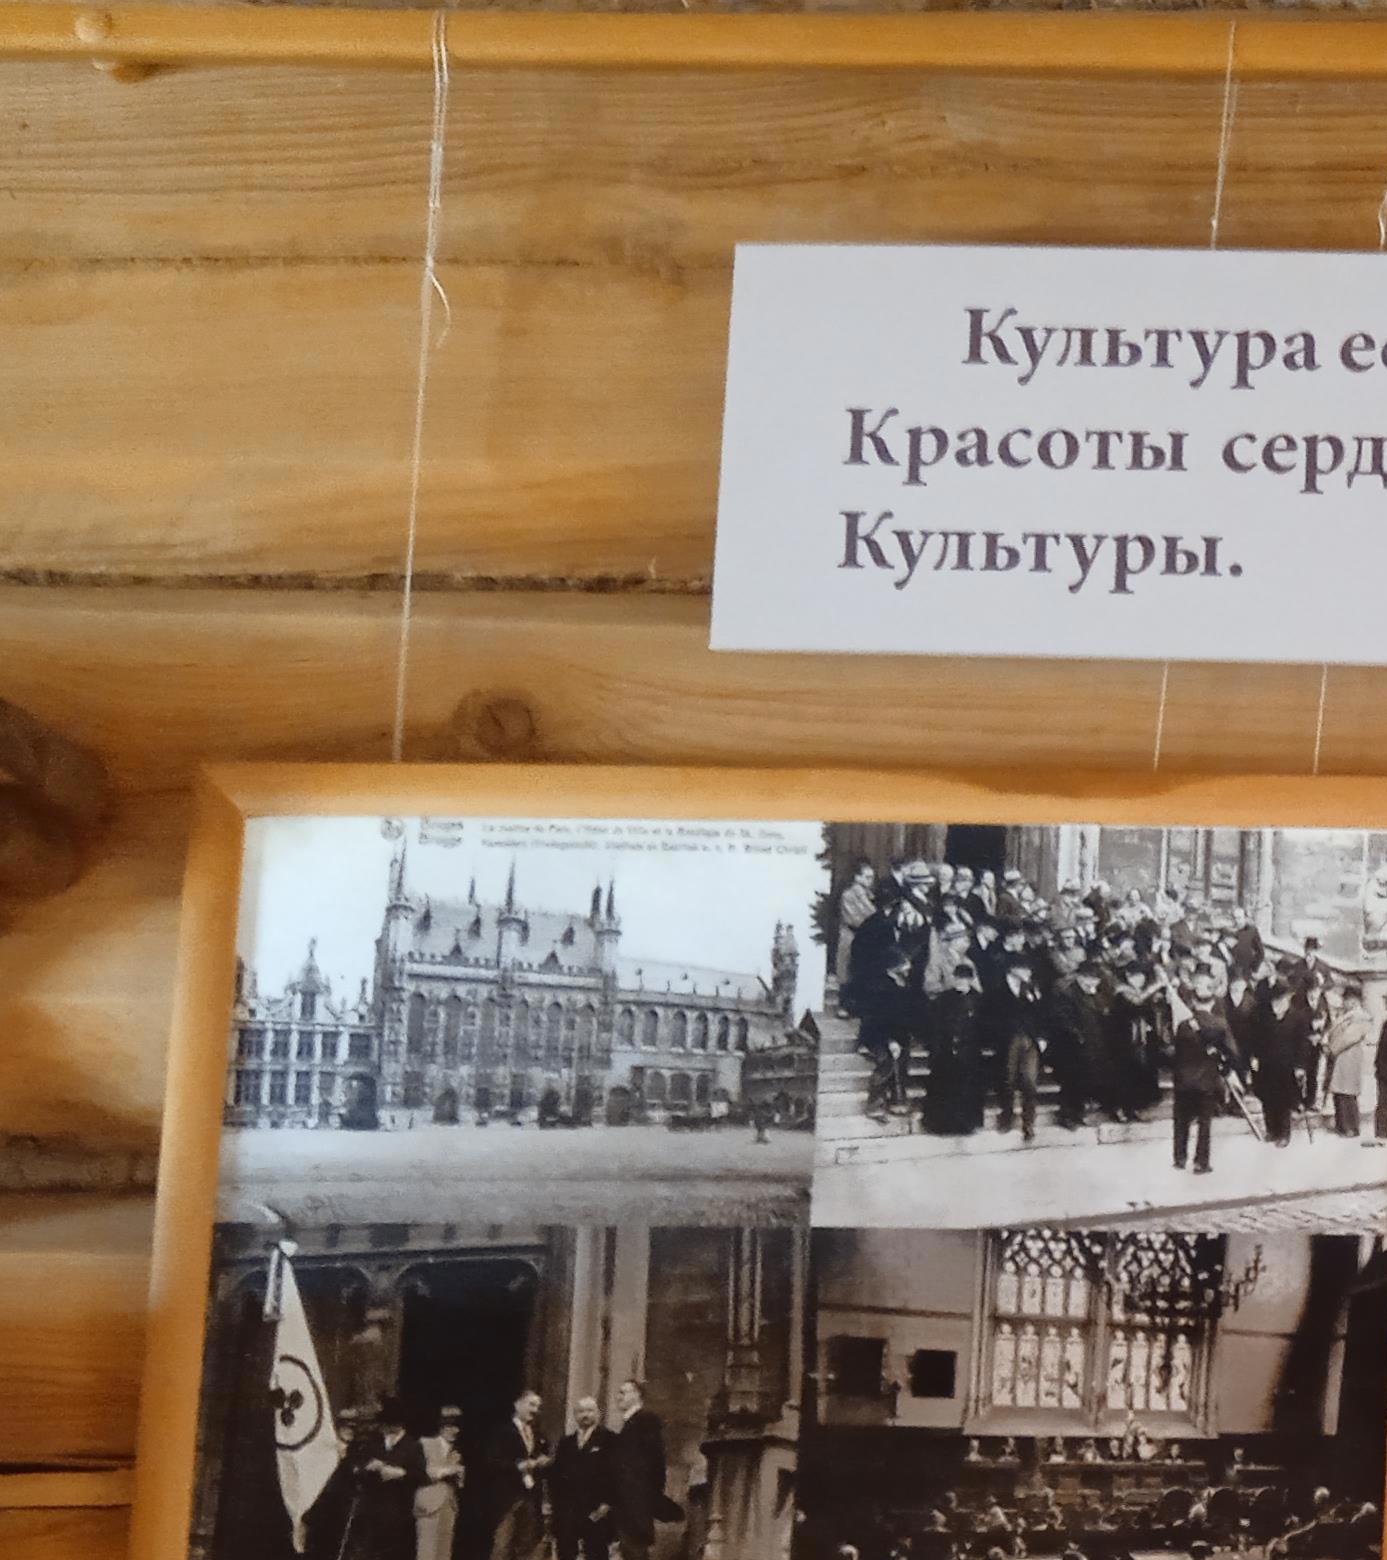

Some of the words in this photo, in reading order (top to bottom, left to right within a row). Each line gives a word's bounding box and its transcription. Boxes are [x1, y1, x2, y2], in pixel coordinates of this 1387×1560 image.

[962, 308, 1321, 390] Культура
[843, 408, 1189, 486] Красоты
[837, 510, 1243, 594] Культуры.
